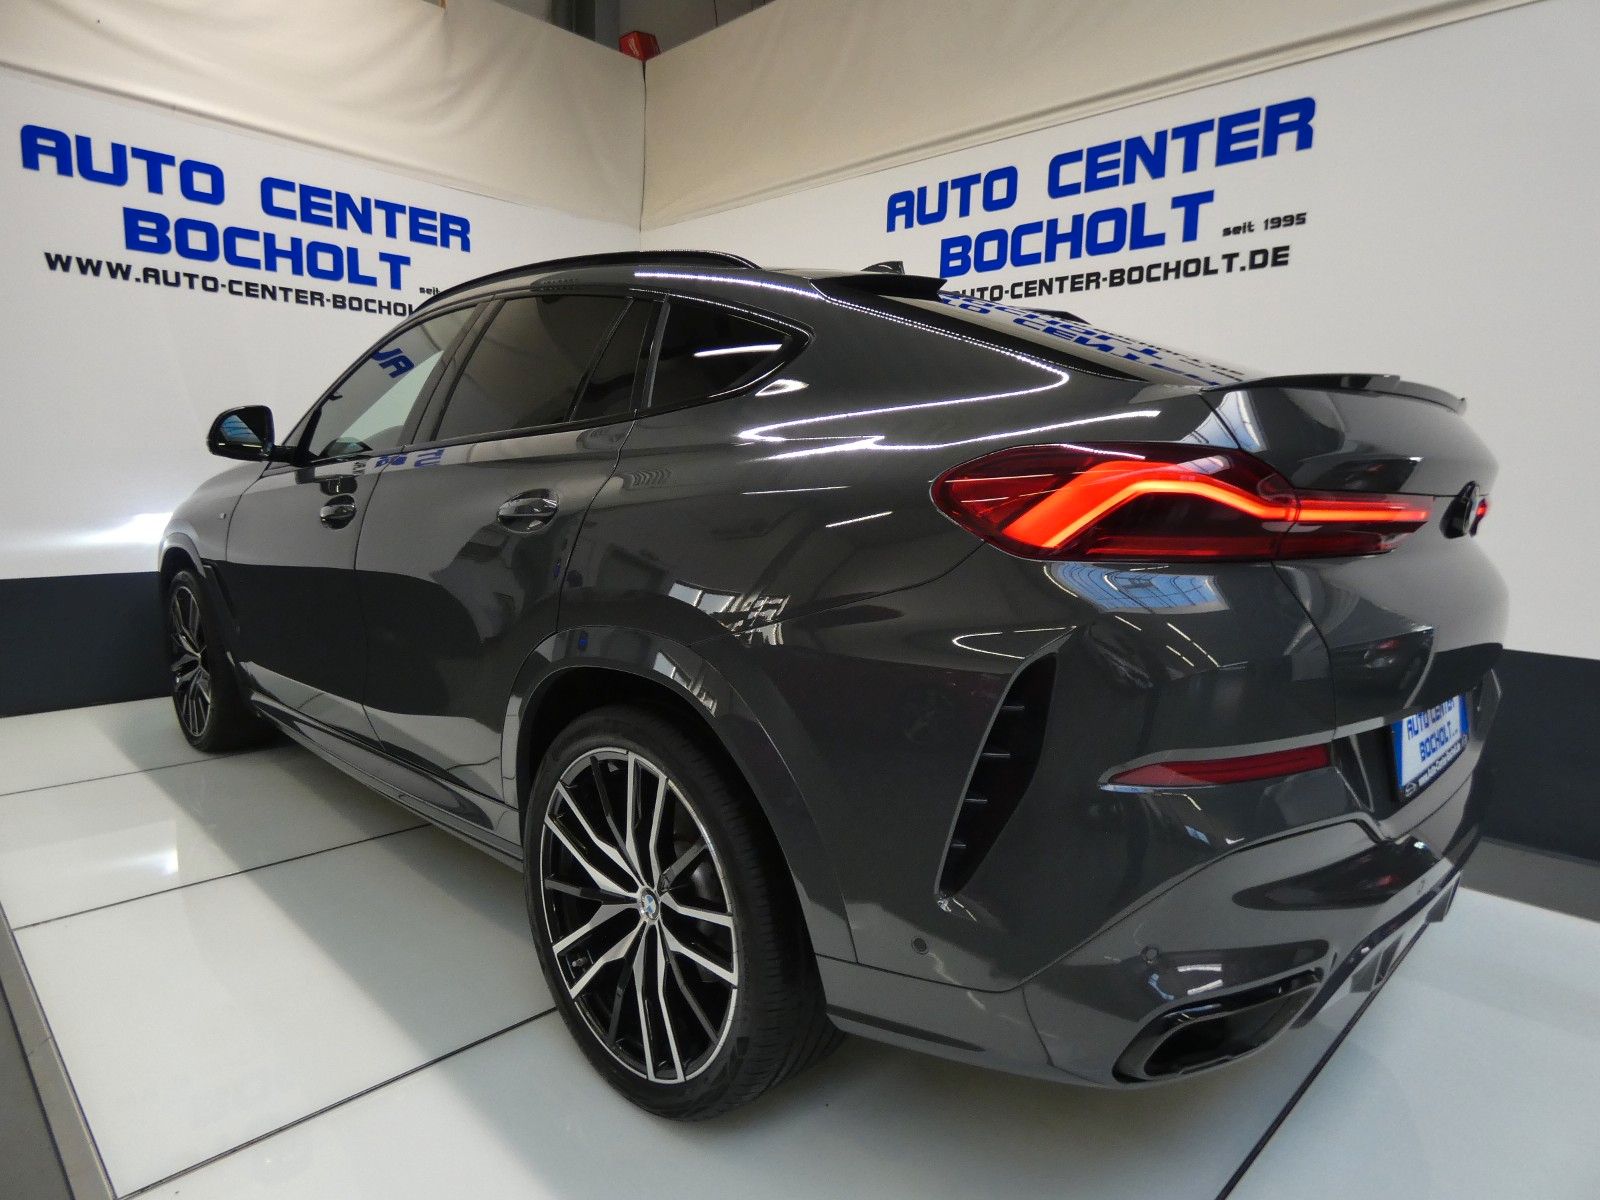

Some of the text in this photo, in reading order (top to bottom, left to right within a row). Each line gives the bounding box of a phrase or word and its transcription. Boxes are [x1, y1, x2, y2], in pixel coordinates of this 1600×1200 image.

[20, 124, 471, 253] AUTO CENTER
[886, 97, 1316, 233] AUTO CENTER
[122, 206, 411, 291] BOCHOLT
[939, 190, 1214, 279] BOCHOLT
[1222, 212, 1307, 237] seit 1995
[1418, 719, 1453, 761] BOCHOLT
